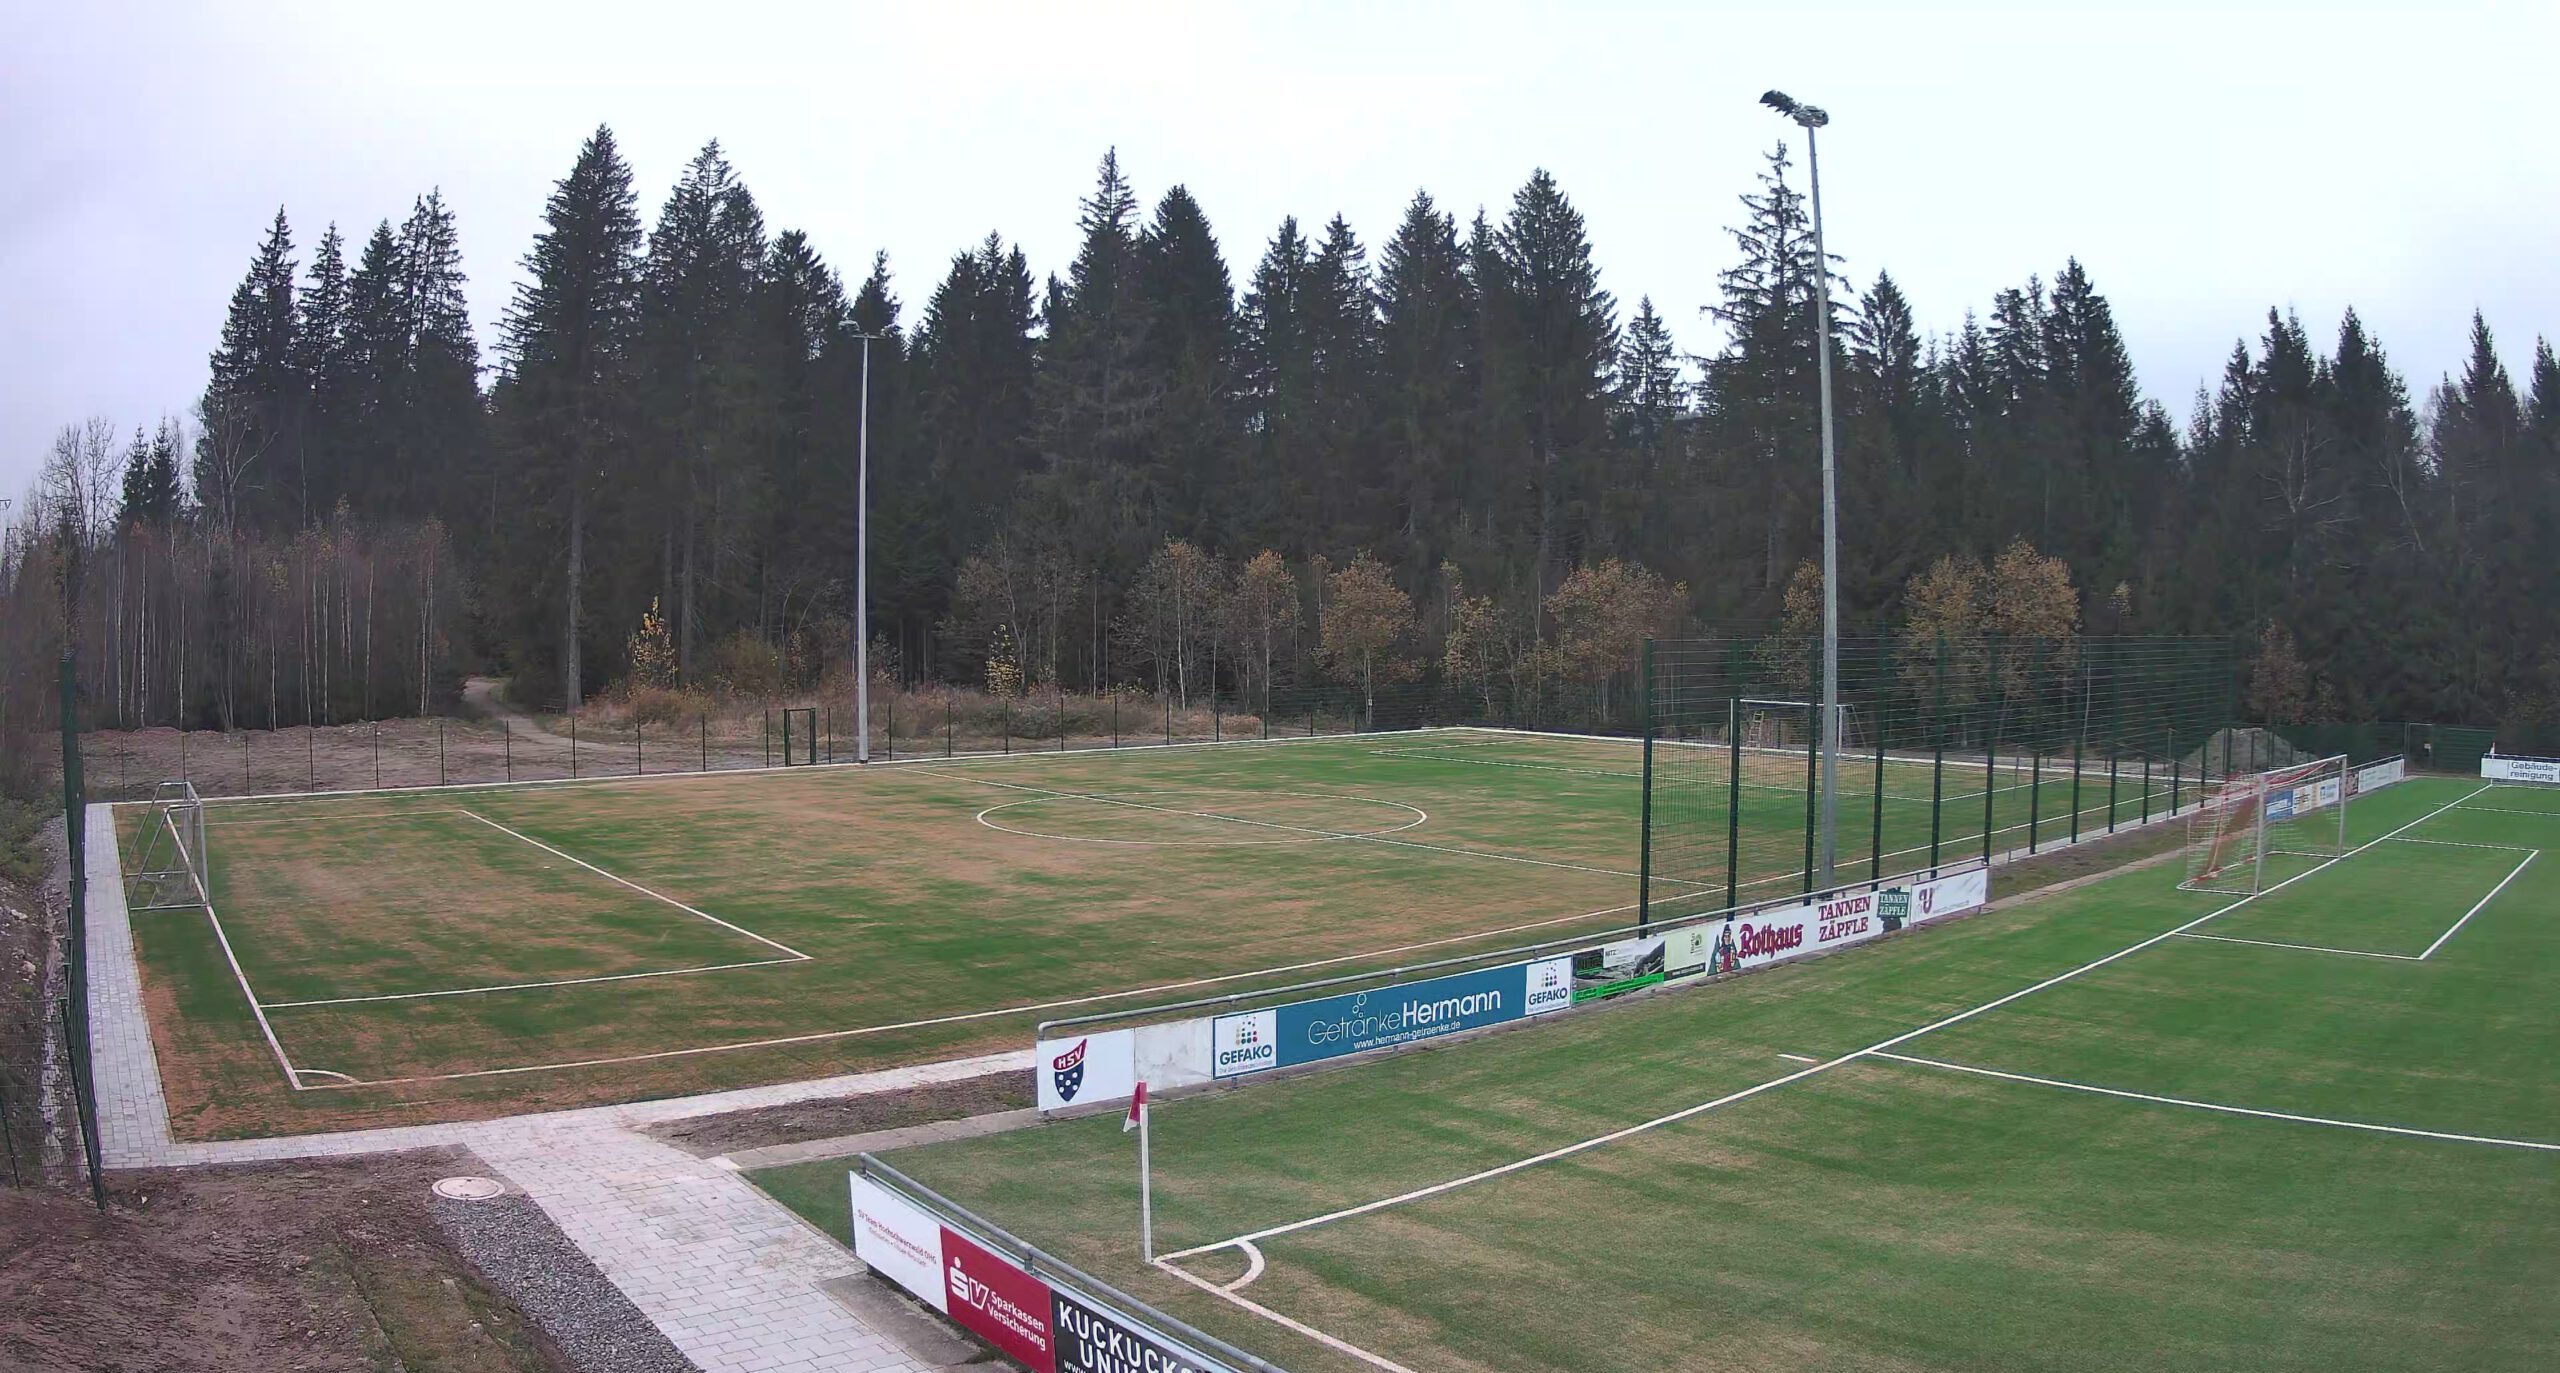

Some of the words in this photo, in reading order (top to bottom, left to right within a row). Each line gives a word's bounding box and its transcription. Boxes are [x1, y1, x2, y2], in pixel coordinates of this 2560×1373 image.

[2510, 770, 2554, 780] reinigung
[1818, 895, 1871, 921] TANNEN
[1879, 903, 1907, 915] ZÄPFLE
[1880, 893, 1909, 904] TANNEN
[1737, 922, 1804, 959] Rothaus
[1818, 916, 1869, 942] ZÄPFLE
[1528, 987, 1568, 1006] GEFAKO
[1058, 1044, 1083, 1069] HSV
[1219, 1044, 1273, 1066] GEFAKO
[990, 1290, 1045, 1333] Sparkassen
[987, 1302, 1046, 1352] Versicherung
[1059, 1301, 1193, 1373] KUCKUCK
